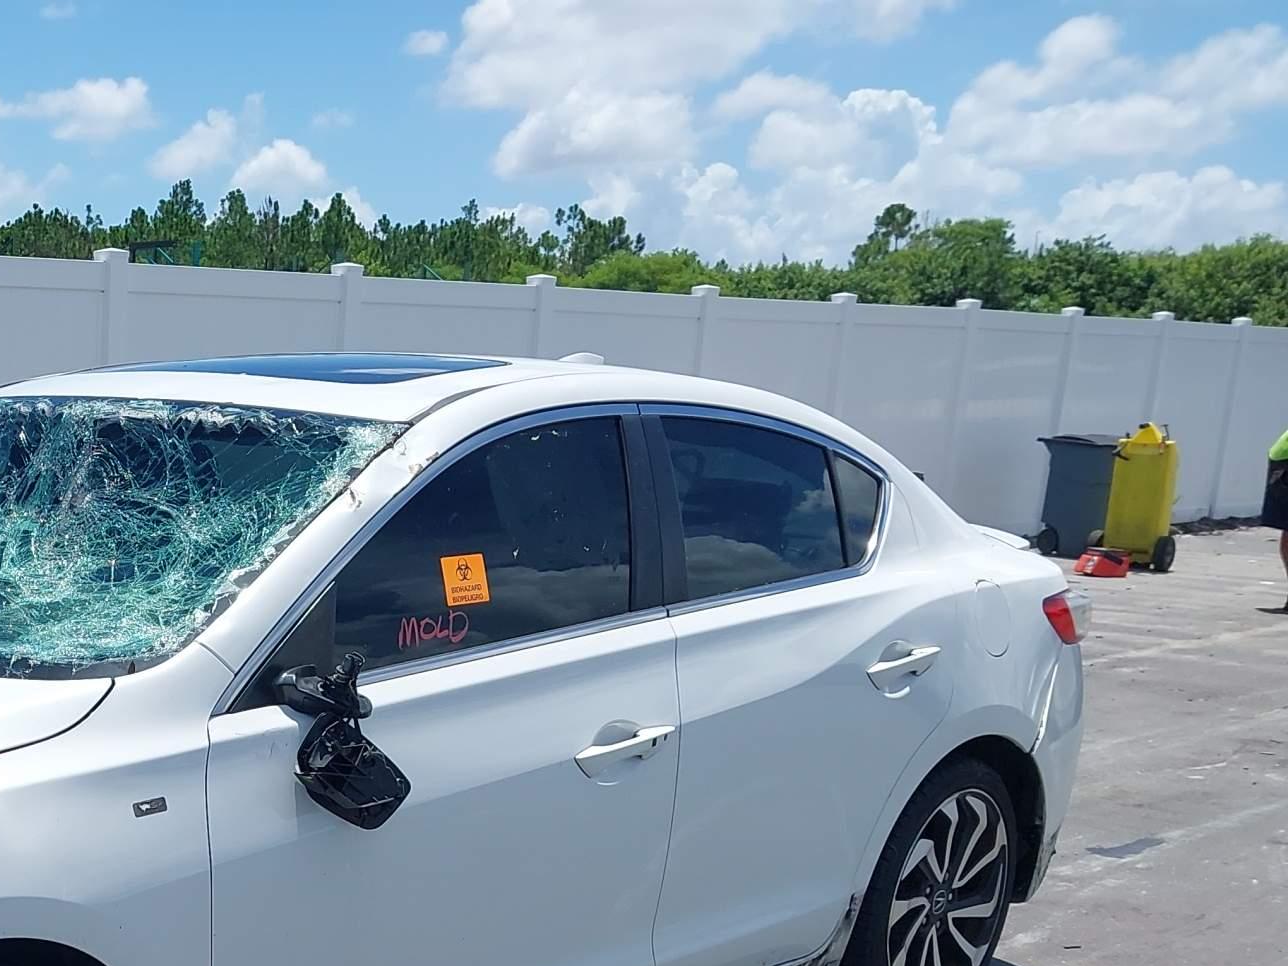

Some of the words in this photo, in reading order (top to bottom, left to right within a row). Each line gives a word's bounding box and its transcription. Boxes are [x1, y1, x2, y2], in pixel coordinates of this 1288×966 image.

[451, 583, 482, 594] BIOHAZARD
[452, 592, 484, 603] BIOPELIGRO
[398, 609, 469, 650] MOLD
